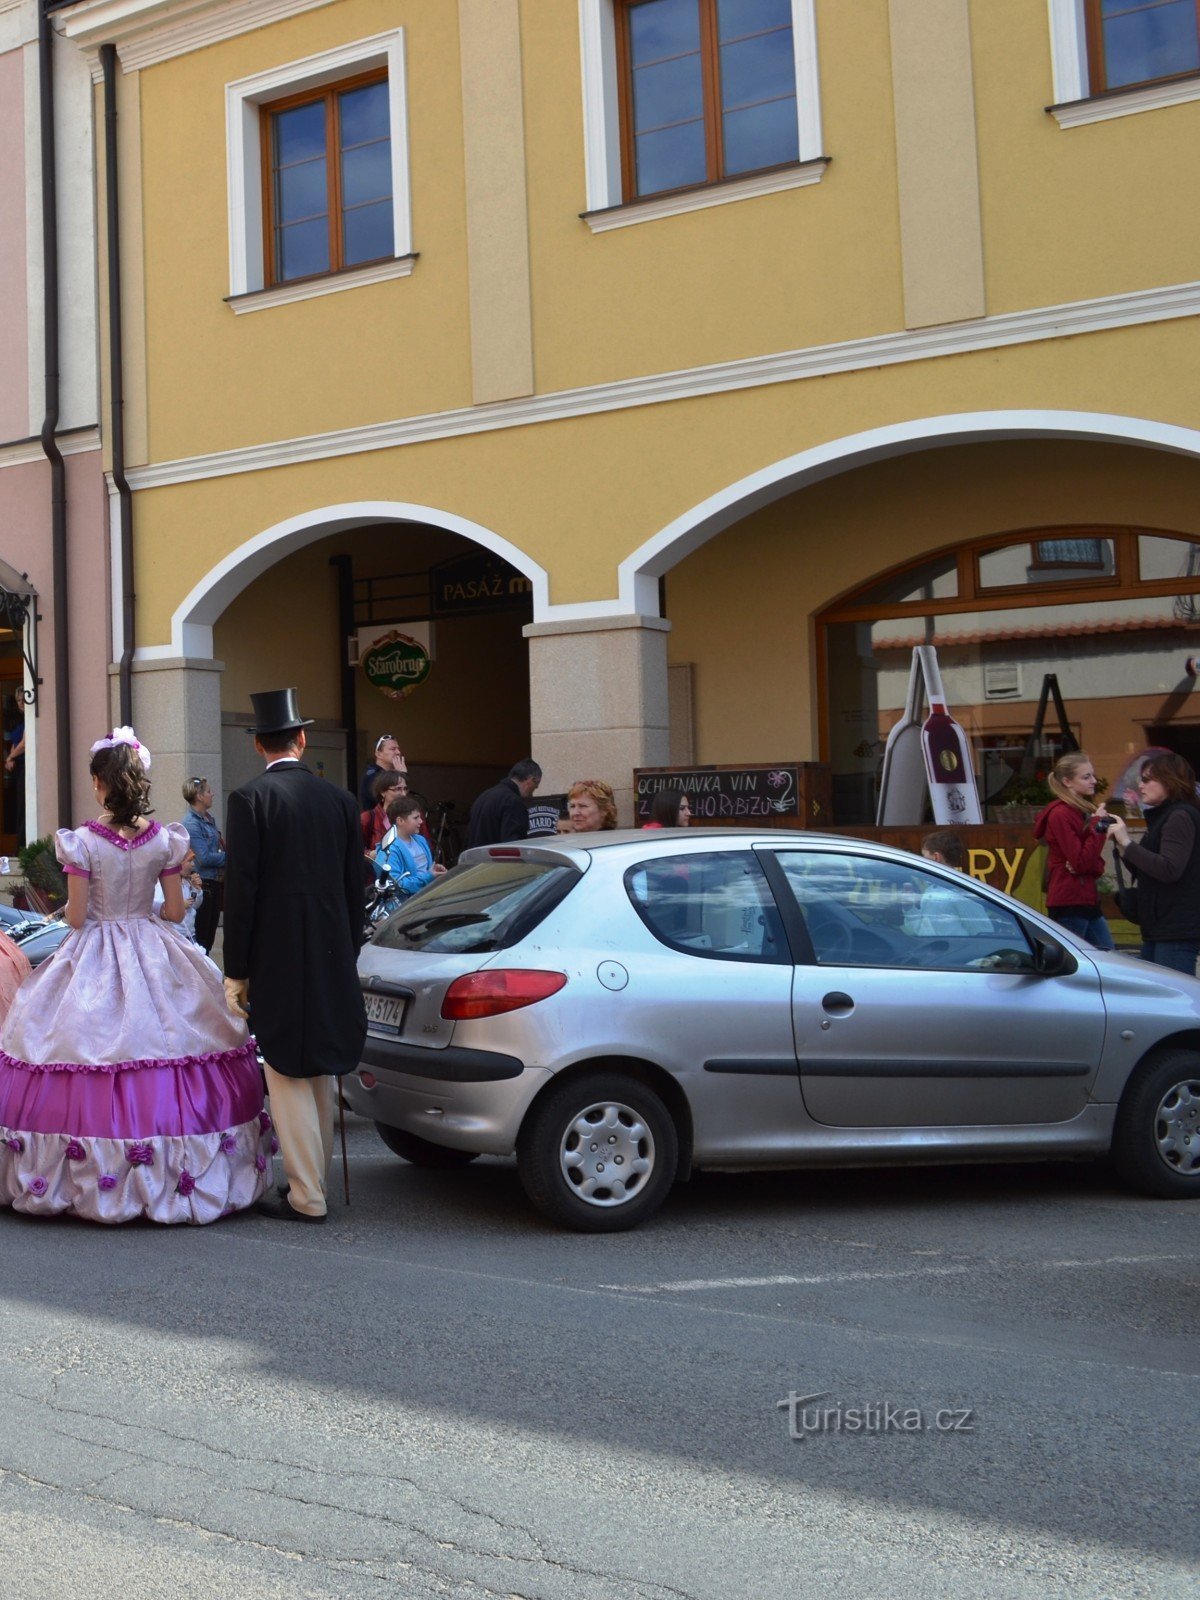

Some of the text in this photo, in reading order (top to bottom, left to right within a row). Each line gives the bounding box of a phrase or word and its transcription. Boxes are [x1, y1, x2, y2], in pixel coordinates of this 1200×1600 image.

[444, 575, 504, 601] PASÁŽ
[368, 650, 427, 682] Starobrno
[529, 816, 552, 830] MARIO
